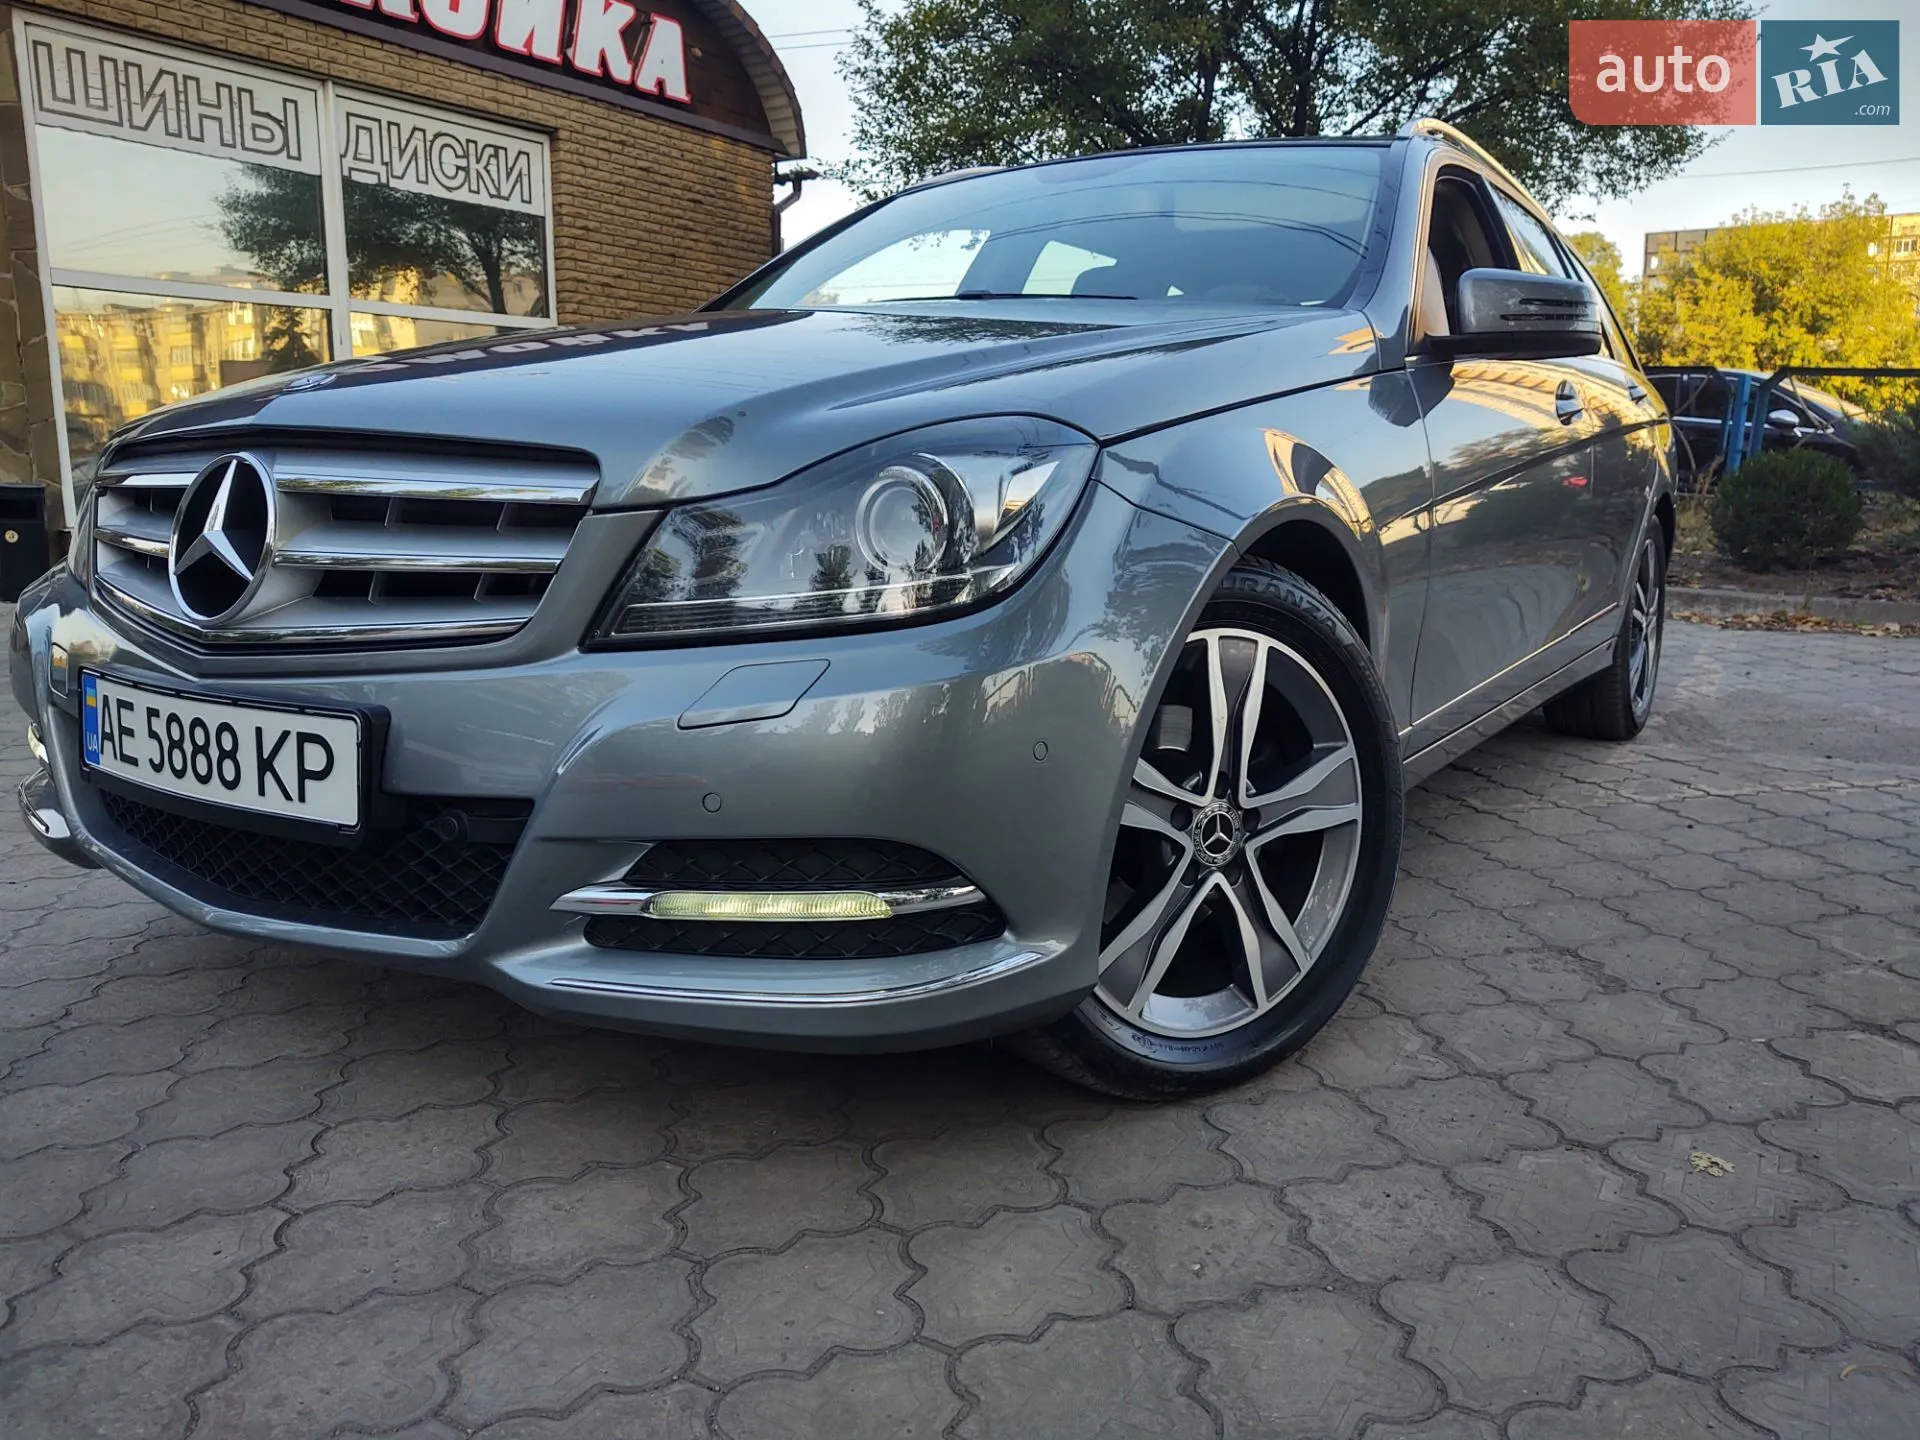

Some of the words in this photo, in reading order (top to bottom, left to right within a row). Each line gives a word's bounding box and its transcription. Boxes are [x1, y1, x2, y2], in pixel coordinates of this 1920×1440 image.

[32, 40, 302, 161] ШИНЫ
[339, 111, 533, 205] ДИСКИ
[86, 731, 99, 752] UA
[100, 693, 139, 767] AE
[146, 706, 242, 791] 5888
[255, 726, 335, 803] KP
